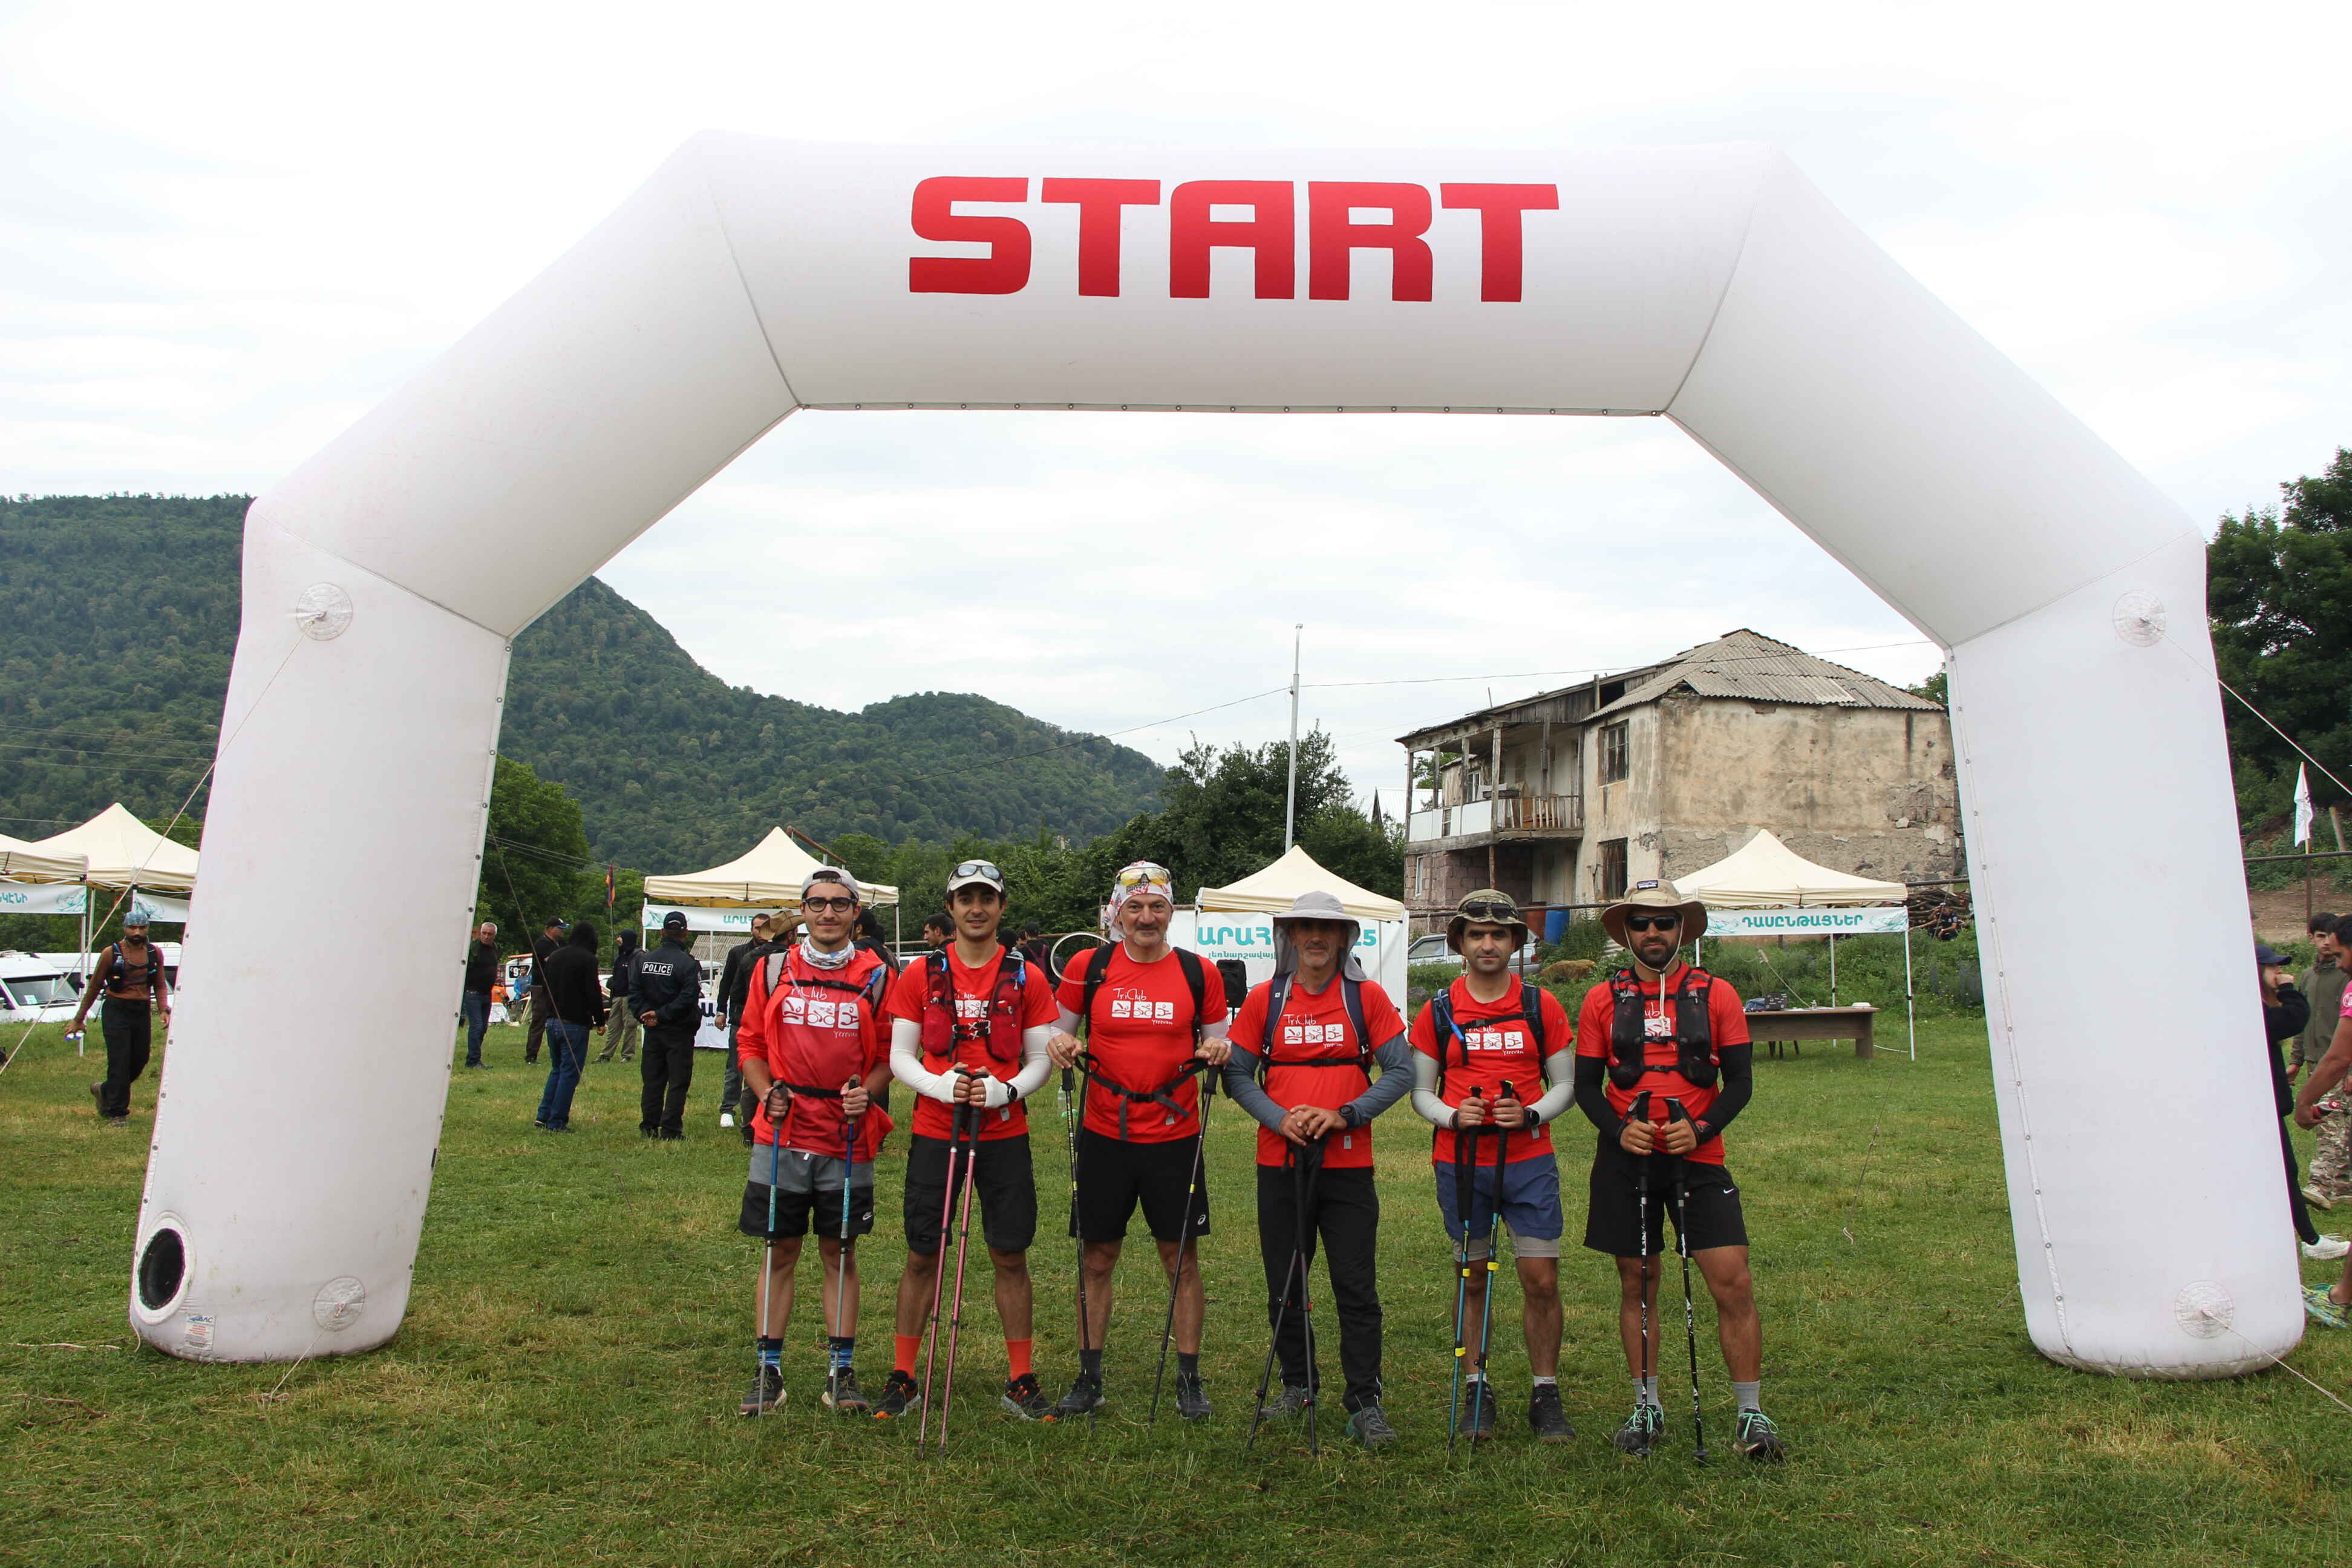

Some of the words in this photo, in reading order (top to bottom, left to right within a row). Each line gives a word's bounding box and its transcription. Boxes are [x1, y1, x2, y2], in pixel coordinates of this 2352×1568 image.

[909, 175, 1559, 302] START
[0, 892, 28, 904] ԿԷՆԻ
[1742, 915, 1863, 928] ԴԱՍԸՆԹԱՑՆԵՐ
[1197, 927, 1272, 946] ԱՐԱՀ
[644, 964, 671, 974] POLICE
[1113, 988, 1147, 1001] TriClub
[1283, 1014, 1316, 1025] TriClub
